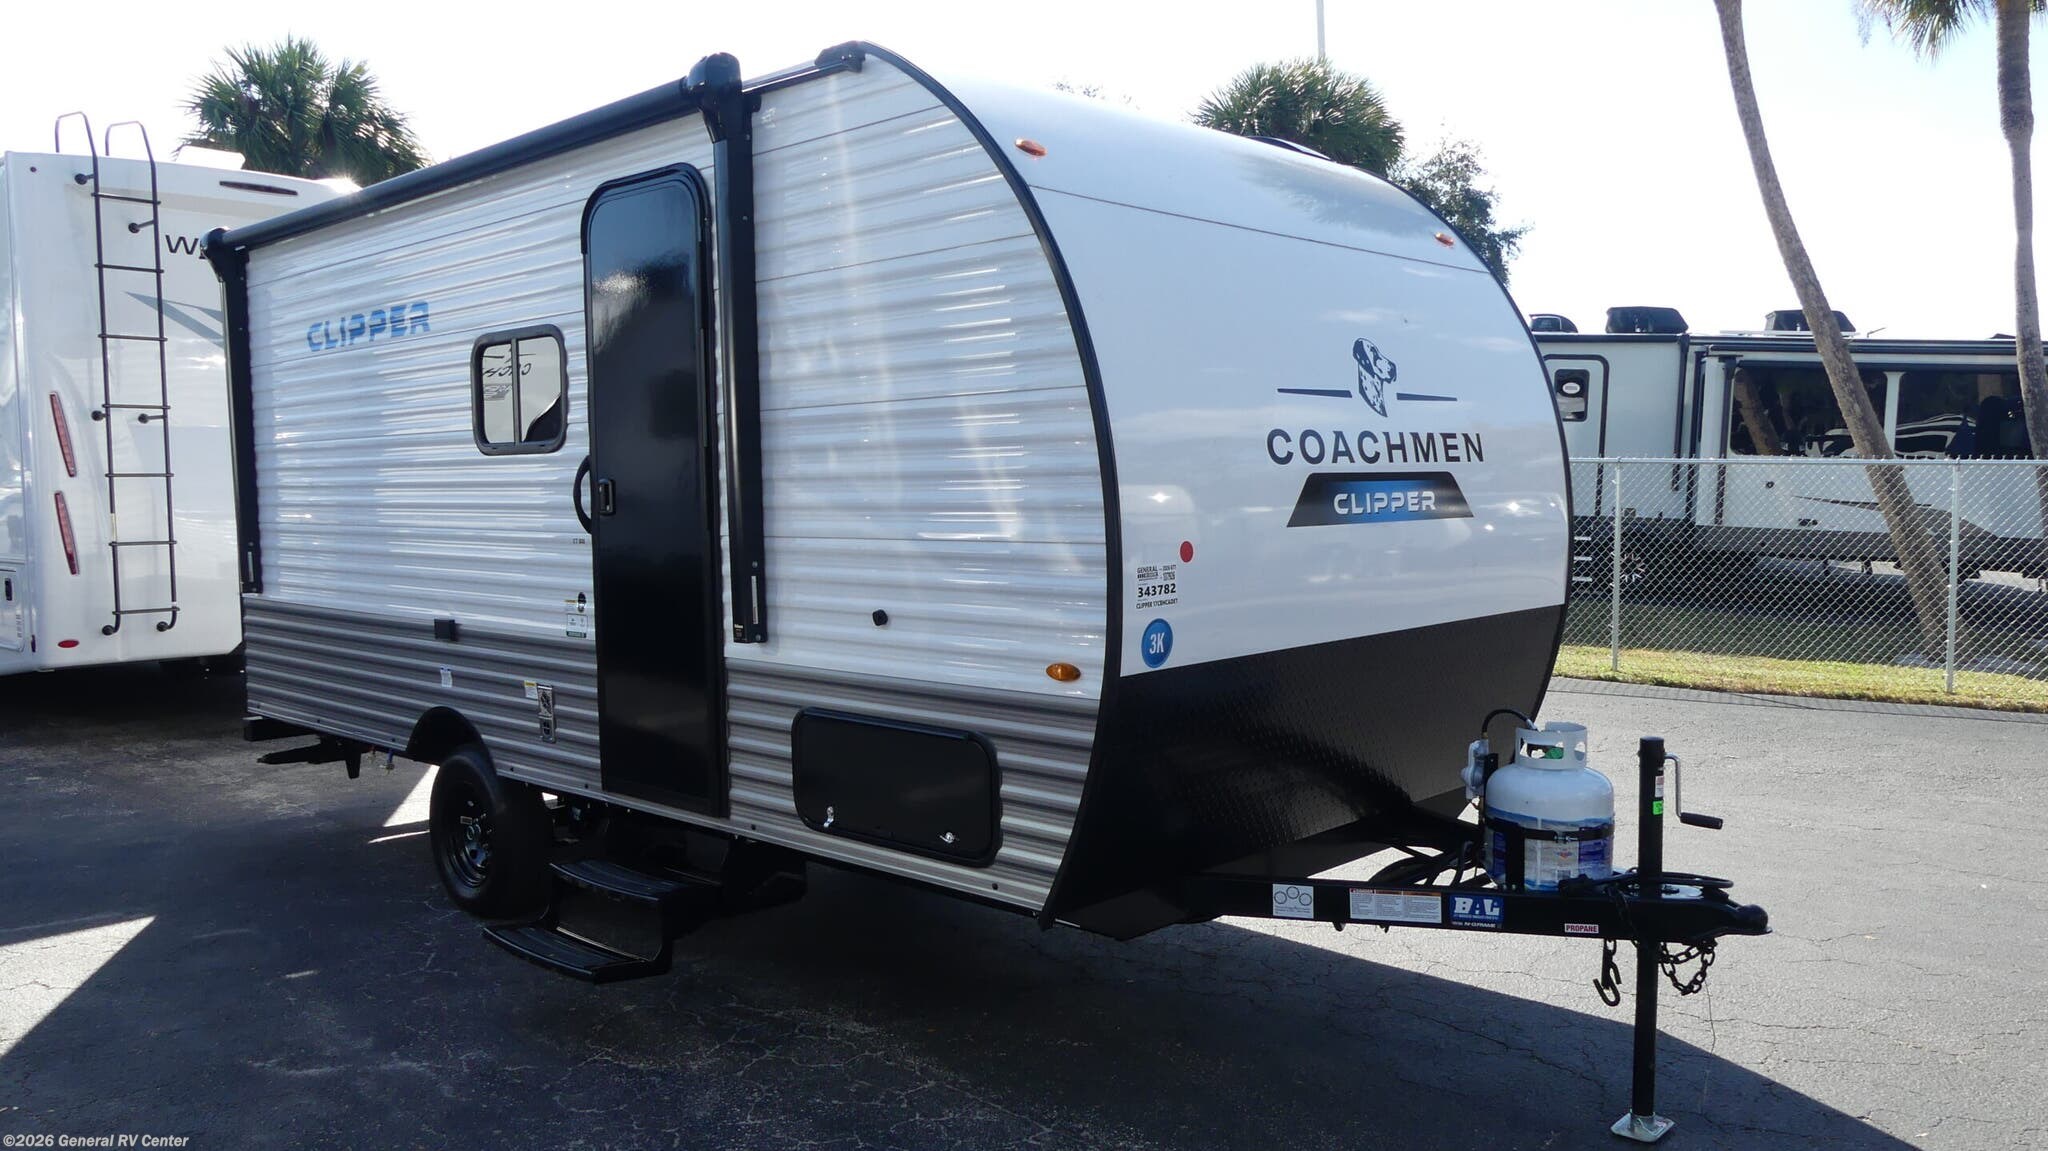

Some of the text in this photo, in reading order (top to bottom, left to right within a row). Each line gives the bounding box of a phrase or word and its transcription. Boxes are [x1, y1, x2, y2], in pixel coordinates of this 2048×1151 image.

[306, 300, 431, 352] CLIPPER
[1266, 428, 1485, 465] COACHMEN
[1333, 490, 1436, 515] CLIPPER
[1137, 583, 1176, 598] 343782
[1149, 632, 1165, 654] 3K
[1454, 897, 1500, 916] BAL
[1566, 925, 1597, 933] PROPANE
